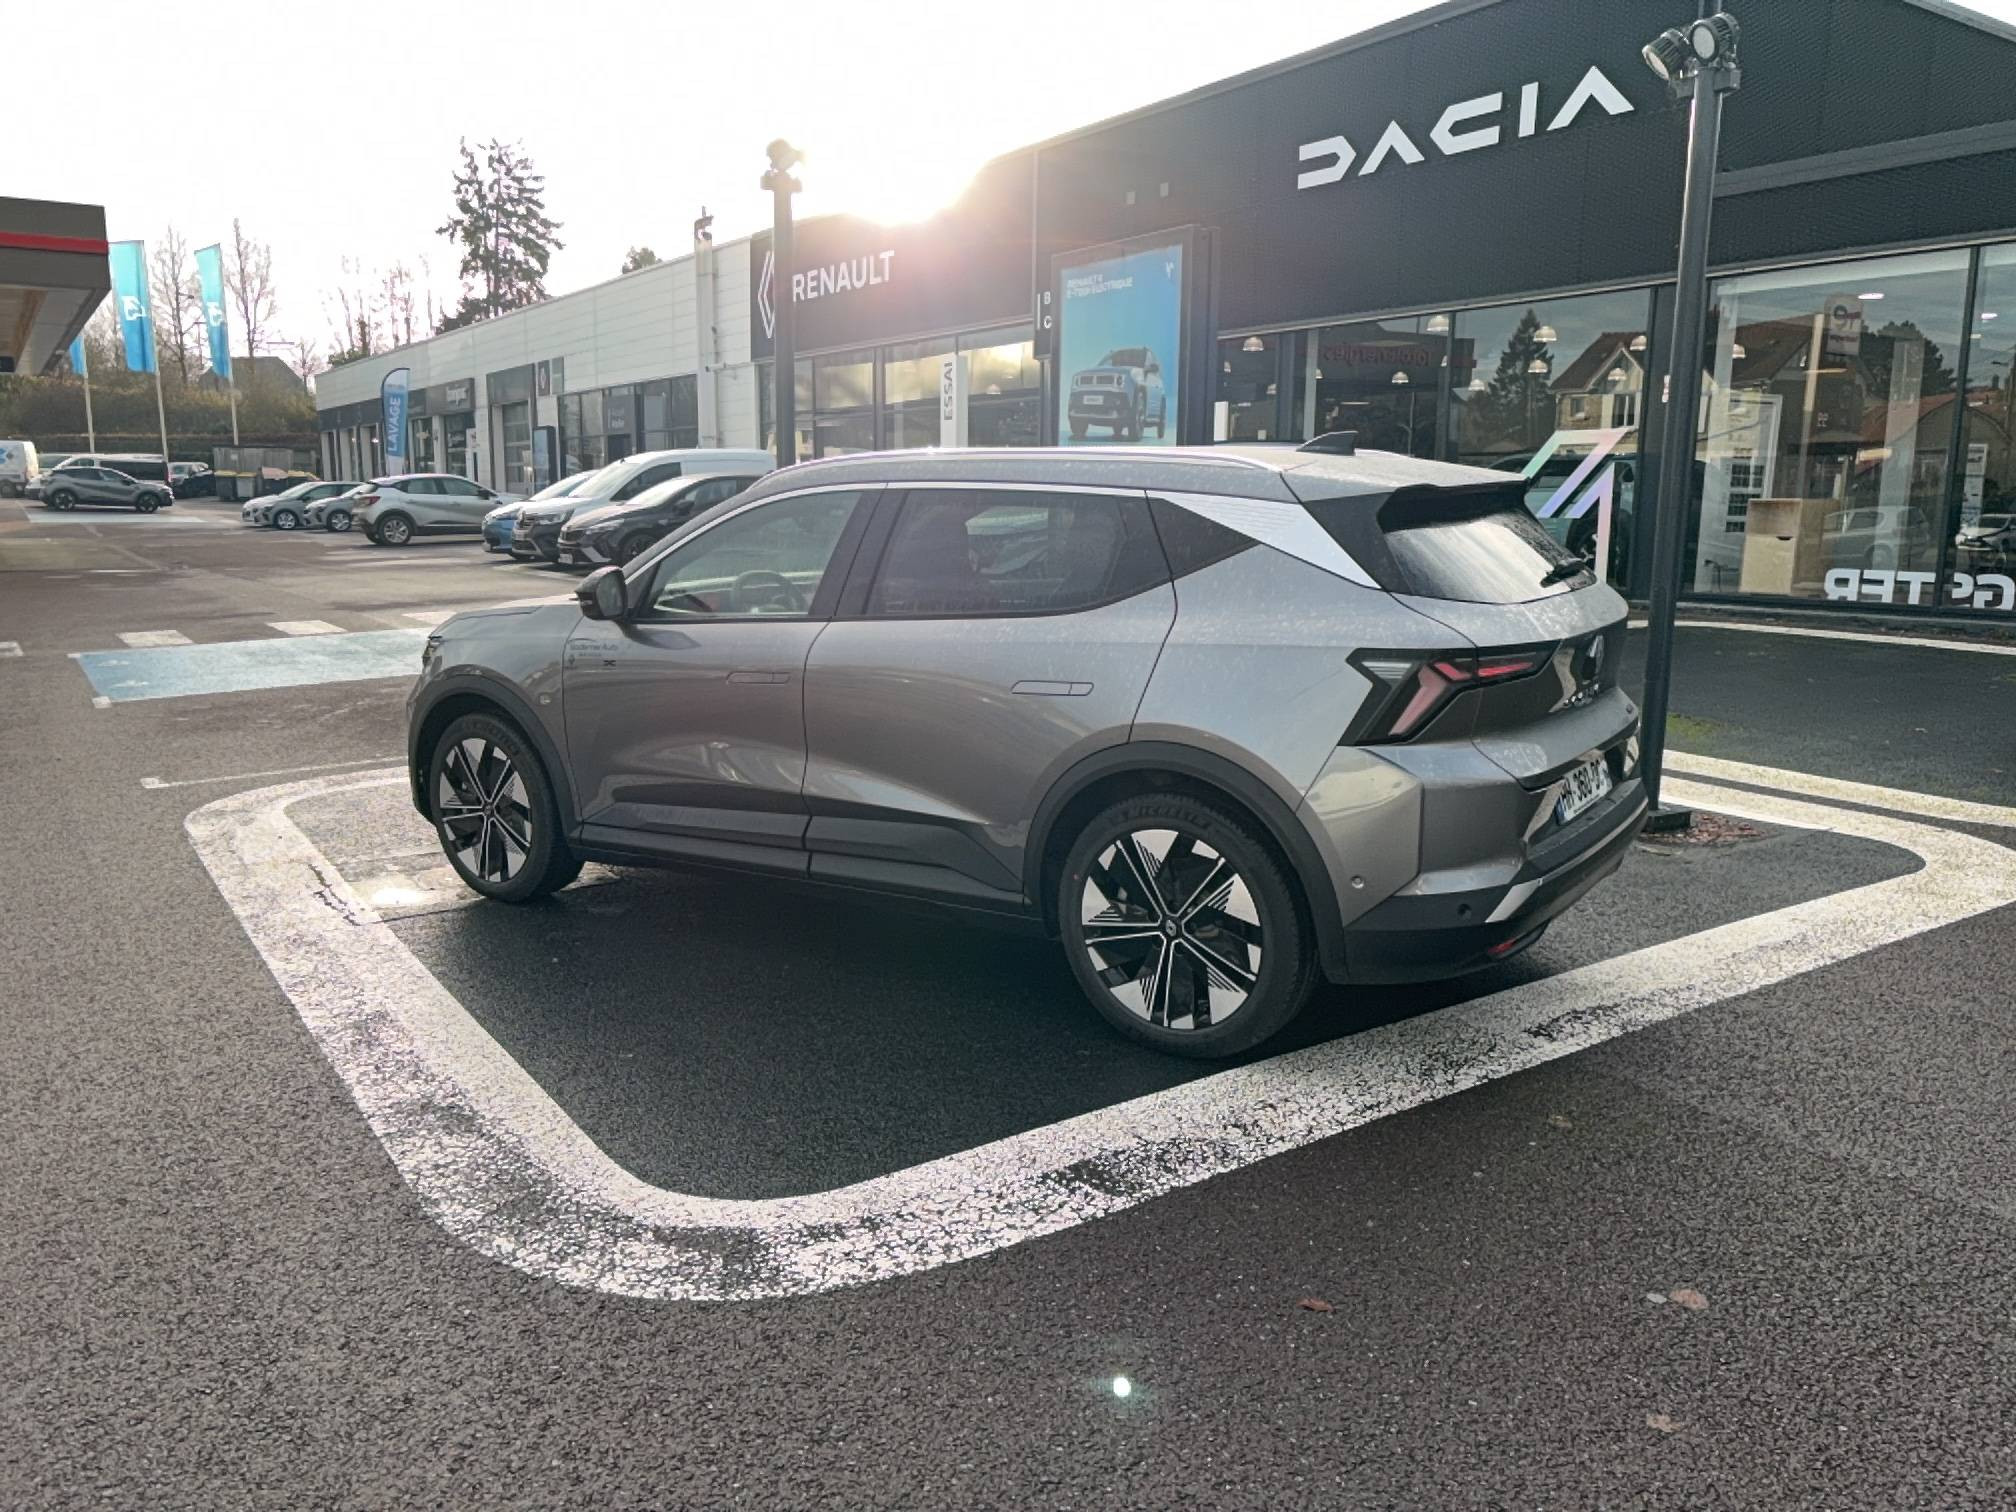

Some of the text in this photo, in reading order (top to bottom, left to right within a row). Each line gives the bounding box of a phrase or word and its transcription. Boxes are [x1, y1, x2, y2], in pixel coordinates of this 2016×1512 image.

[1296, 64, 1635, 190] DACIA
[791, 250, 896, 303] RENAULT
[1043, 315, 1052, 329] C
[942, 361, 954, 421] ESSAI
[387, 395, 401, 452] LAVAGE
